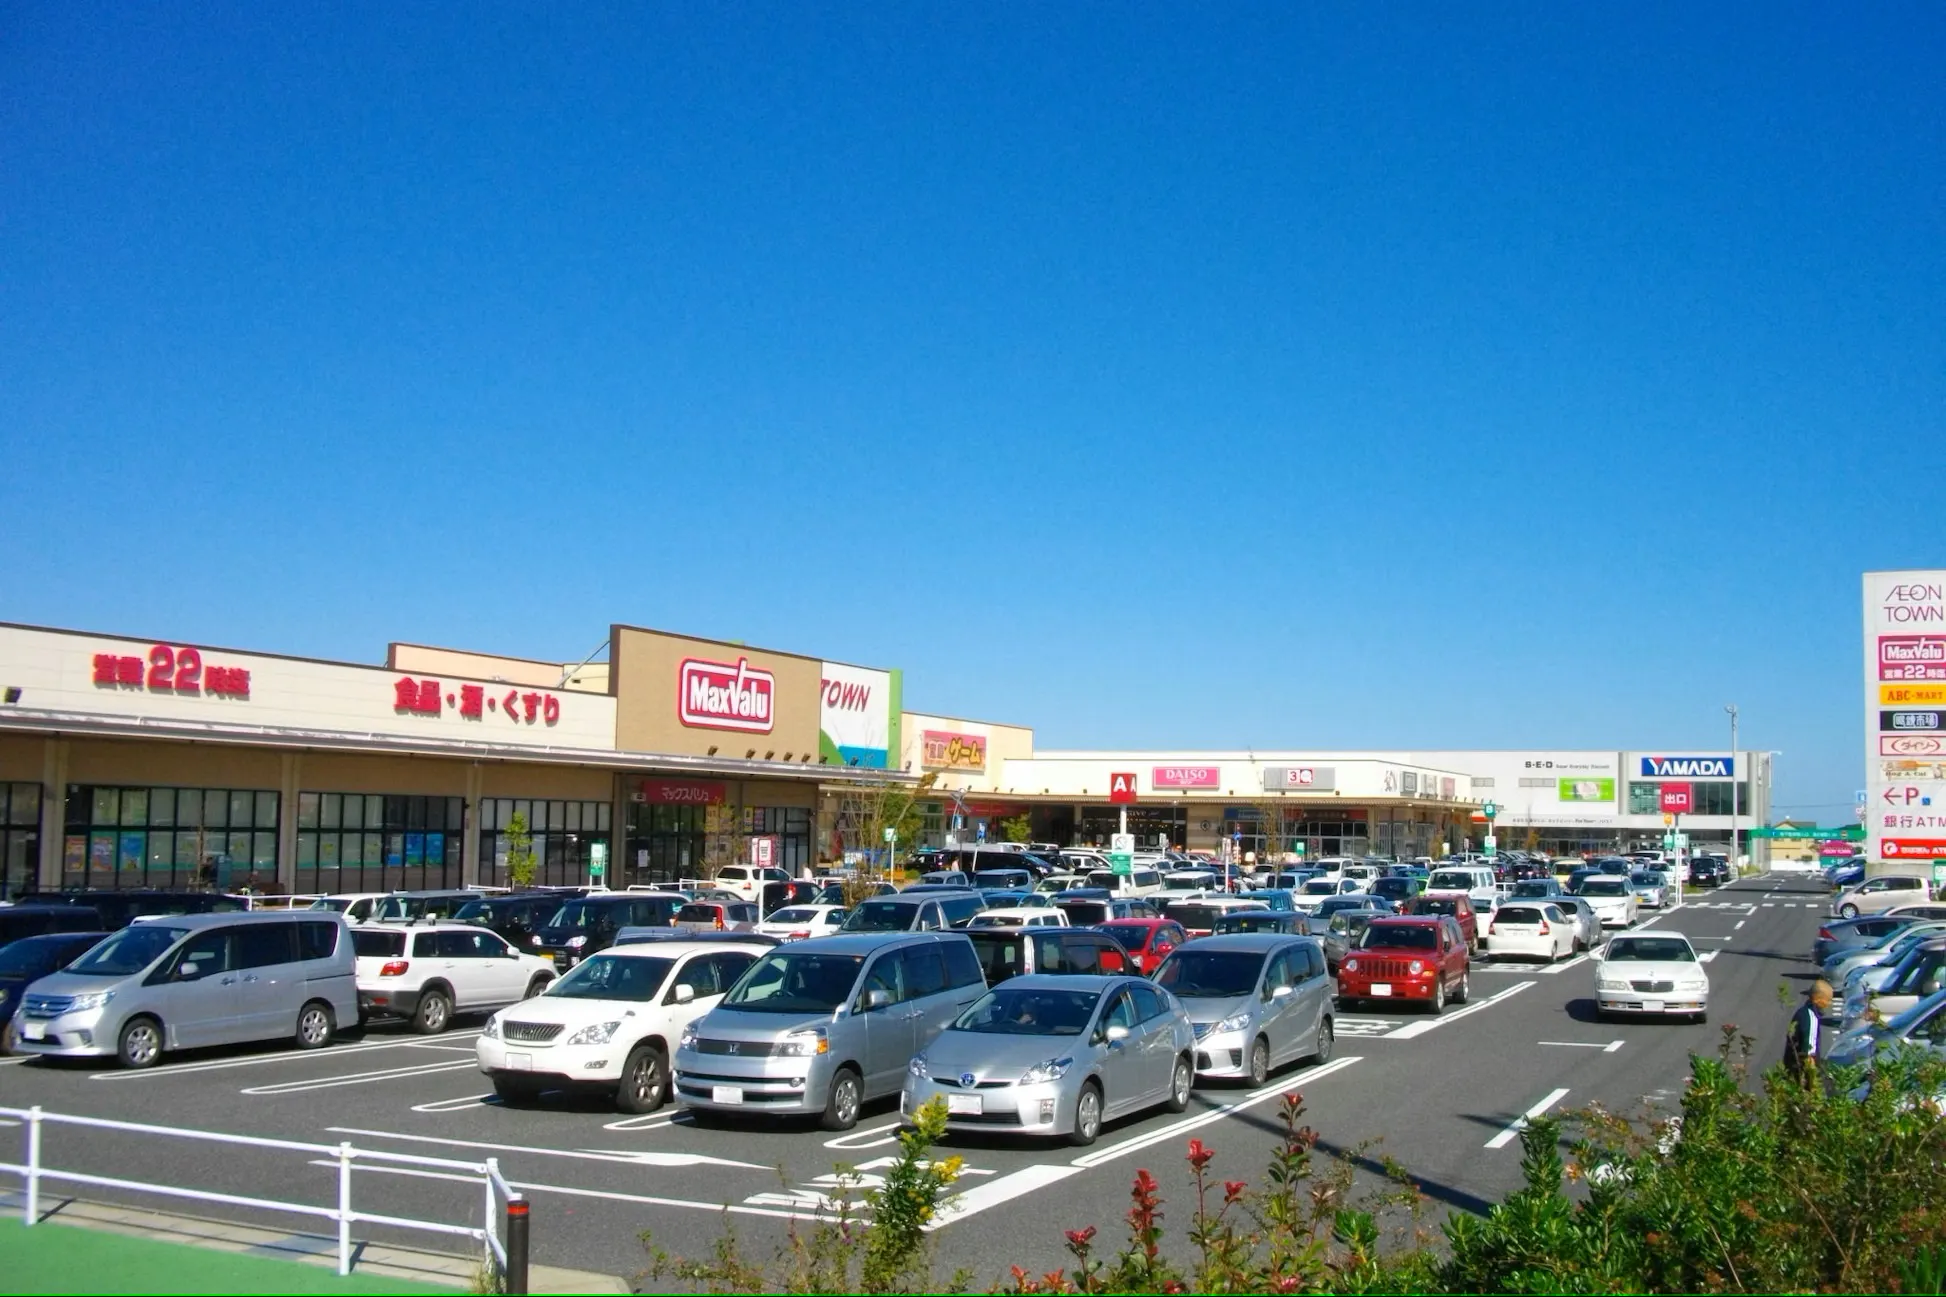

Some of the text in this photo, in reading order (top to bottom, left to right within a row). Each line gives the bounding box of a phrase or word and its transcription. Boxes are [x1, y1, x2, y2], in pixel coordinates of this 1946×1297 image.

[1883, 605, 1944, 622] TOWN
[1886, 637, 1942, 660] MaxValu
[689, 659, 769, 719] MaxValu
[1165, 769, 1208, 780] DAISO
[1648, 758, 1728, 776] YAMADA
[1113, 776, 1128, 793] A
[1664, 793, 1687, 805] 出口
[1905, 787, 1919, 806] P
